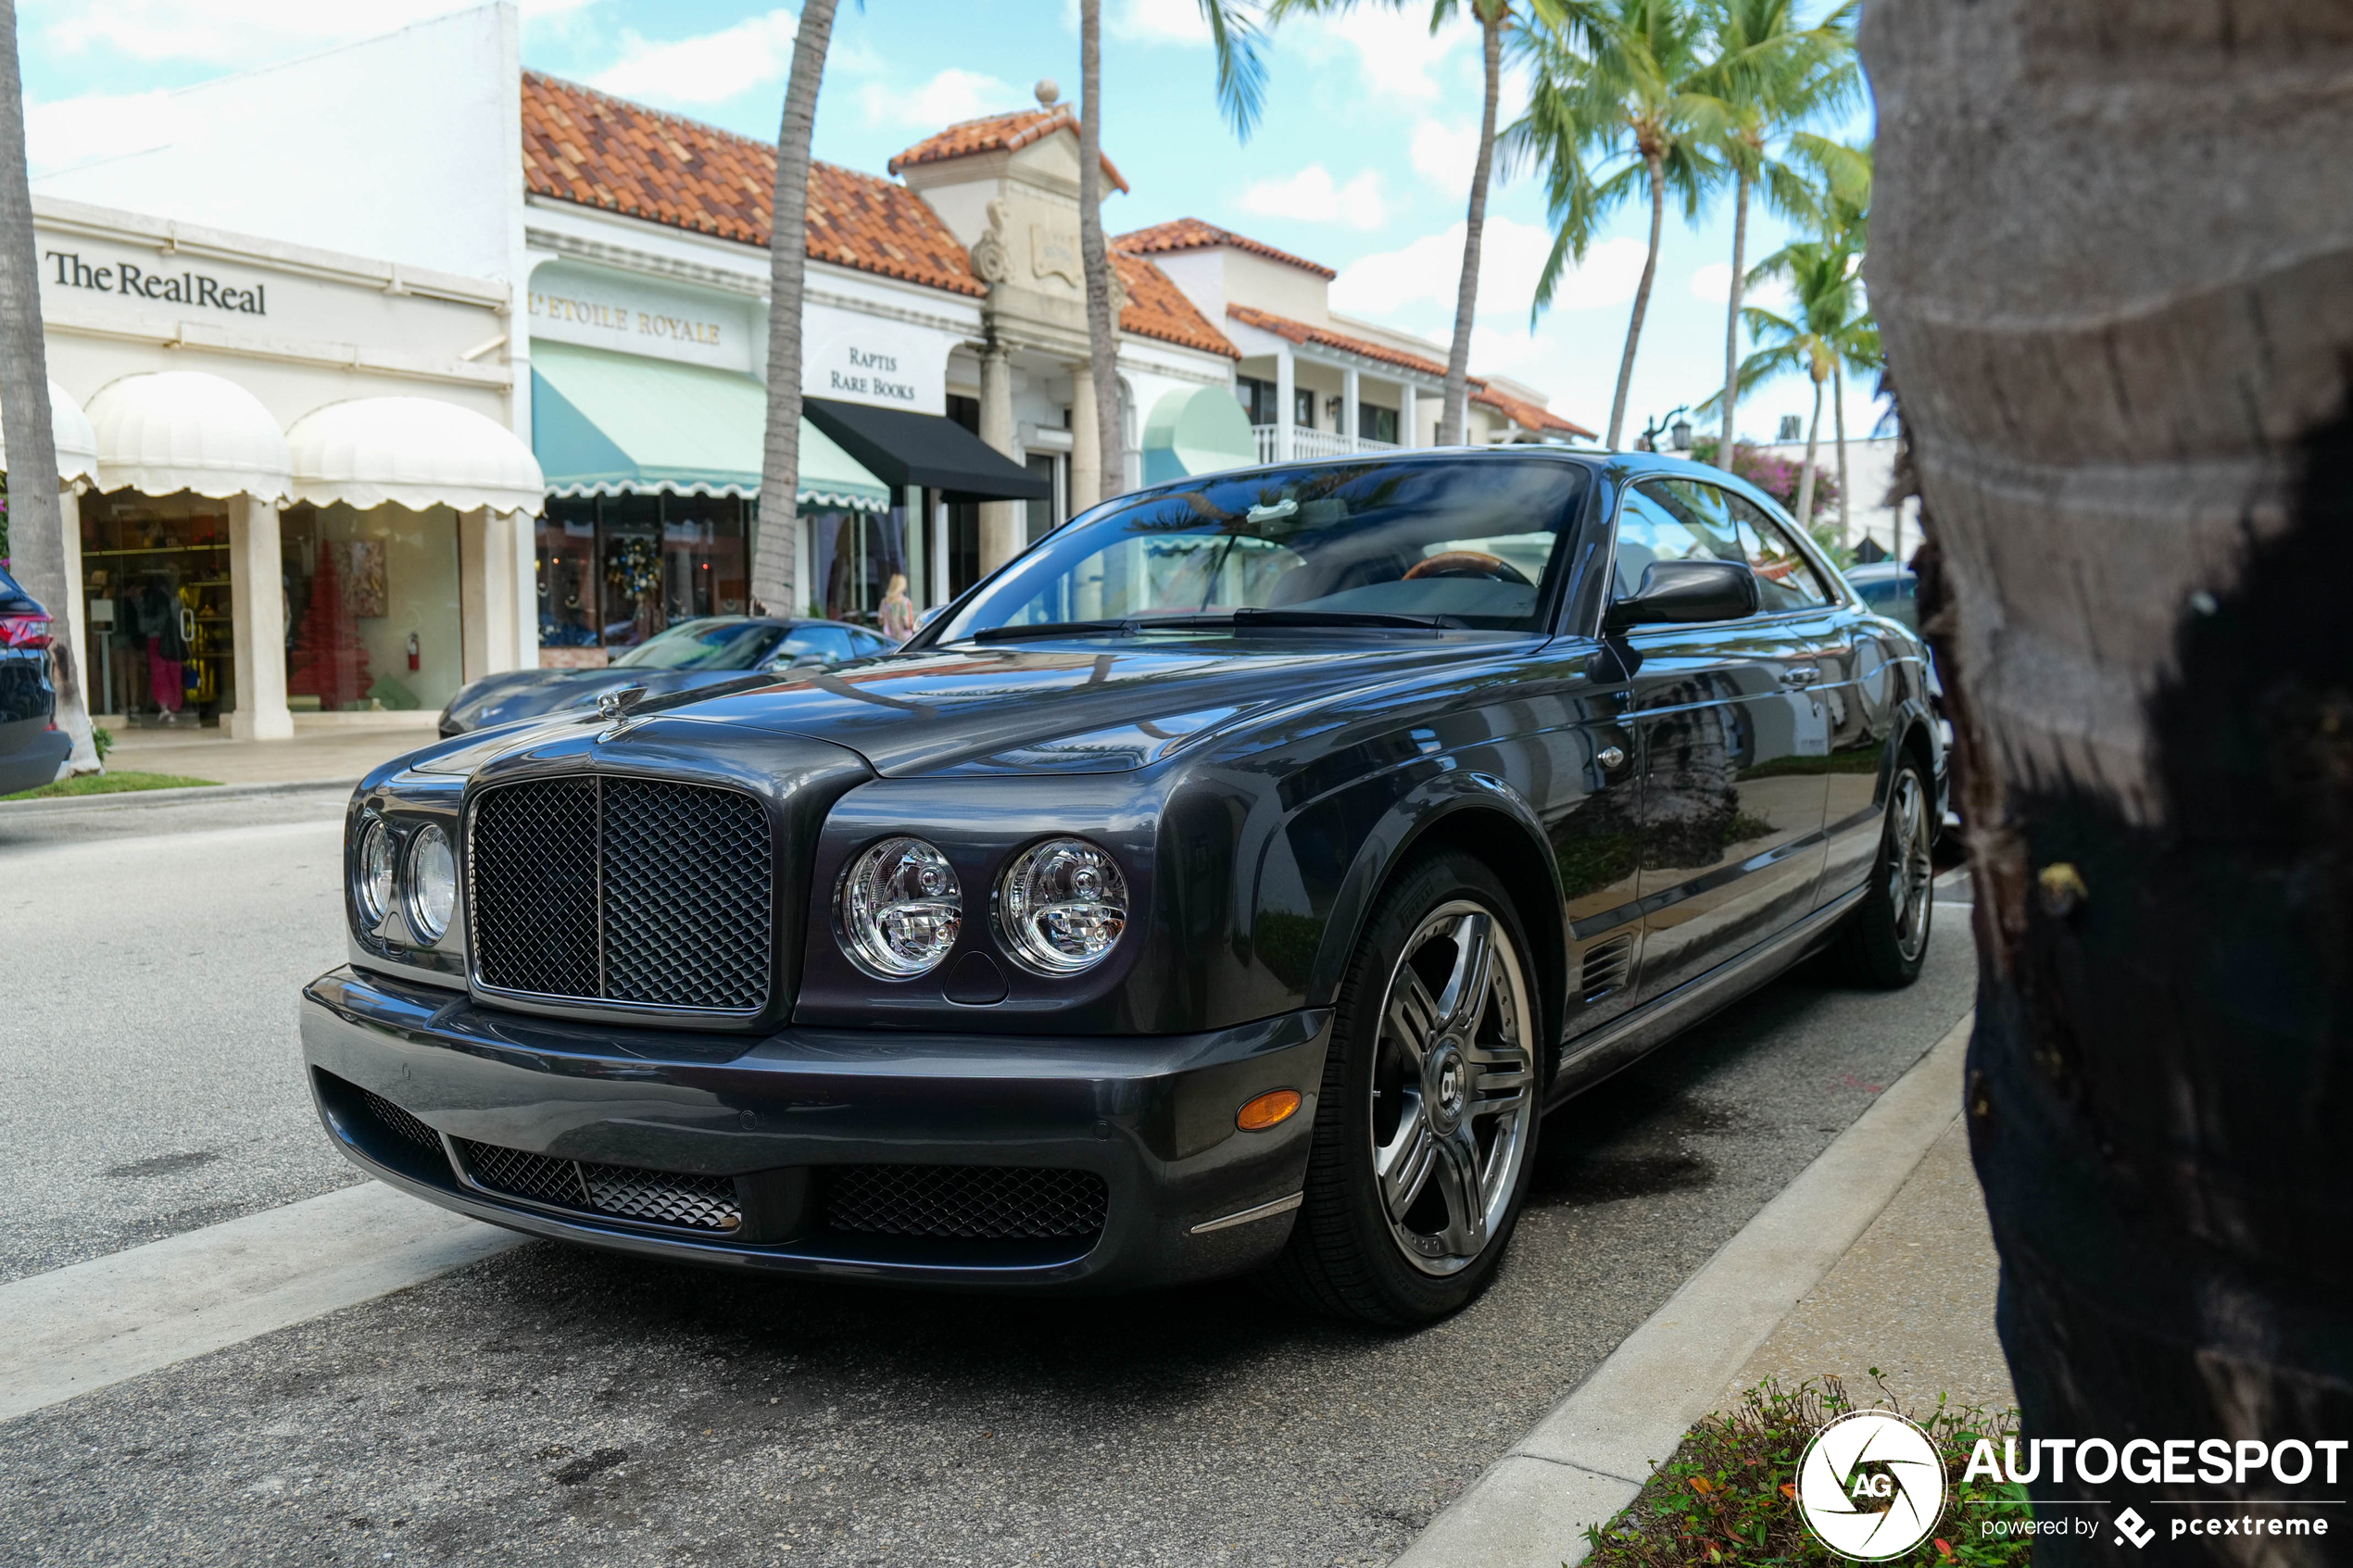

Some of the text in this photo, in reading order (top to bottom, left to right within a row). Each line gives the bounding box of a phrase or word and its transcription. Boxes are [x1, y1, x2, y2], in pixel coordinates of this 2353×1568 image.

[46, 250, 113, 292] The
[528, 293, 721, 345] L'ETOILE ROYALE
[849, 346, 897, 371] RAPTIS
[831, 370, 914, 400] RARE BOOKS
